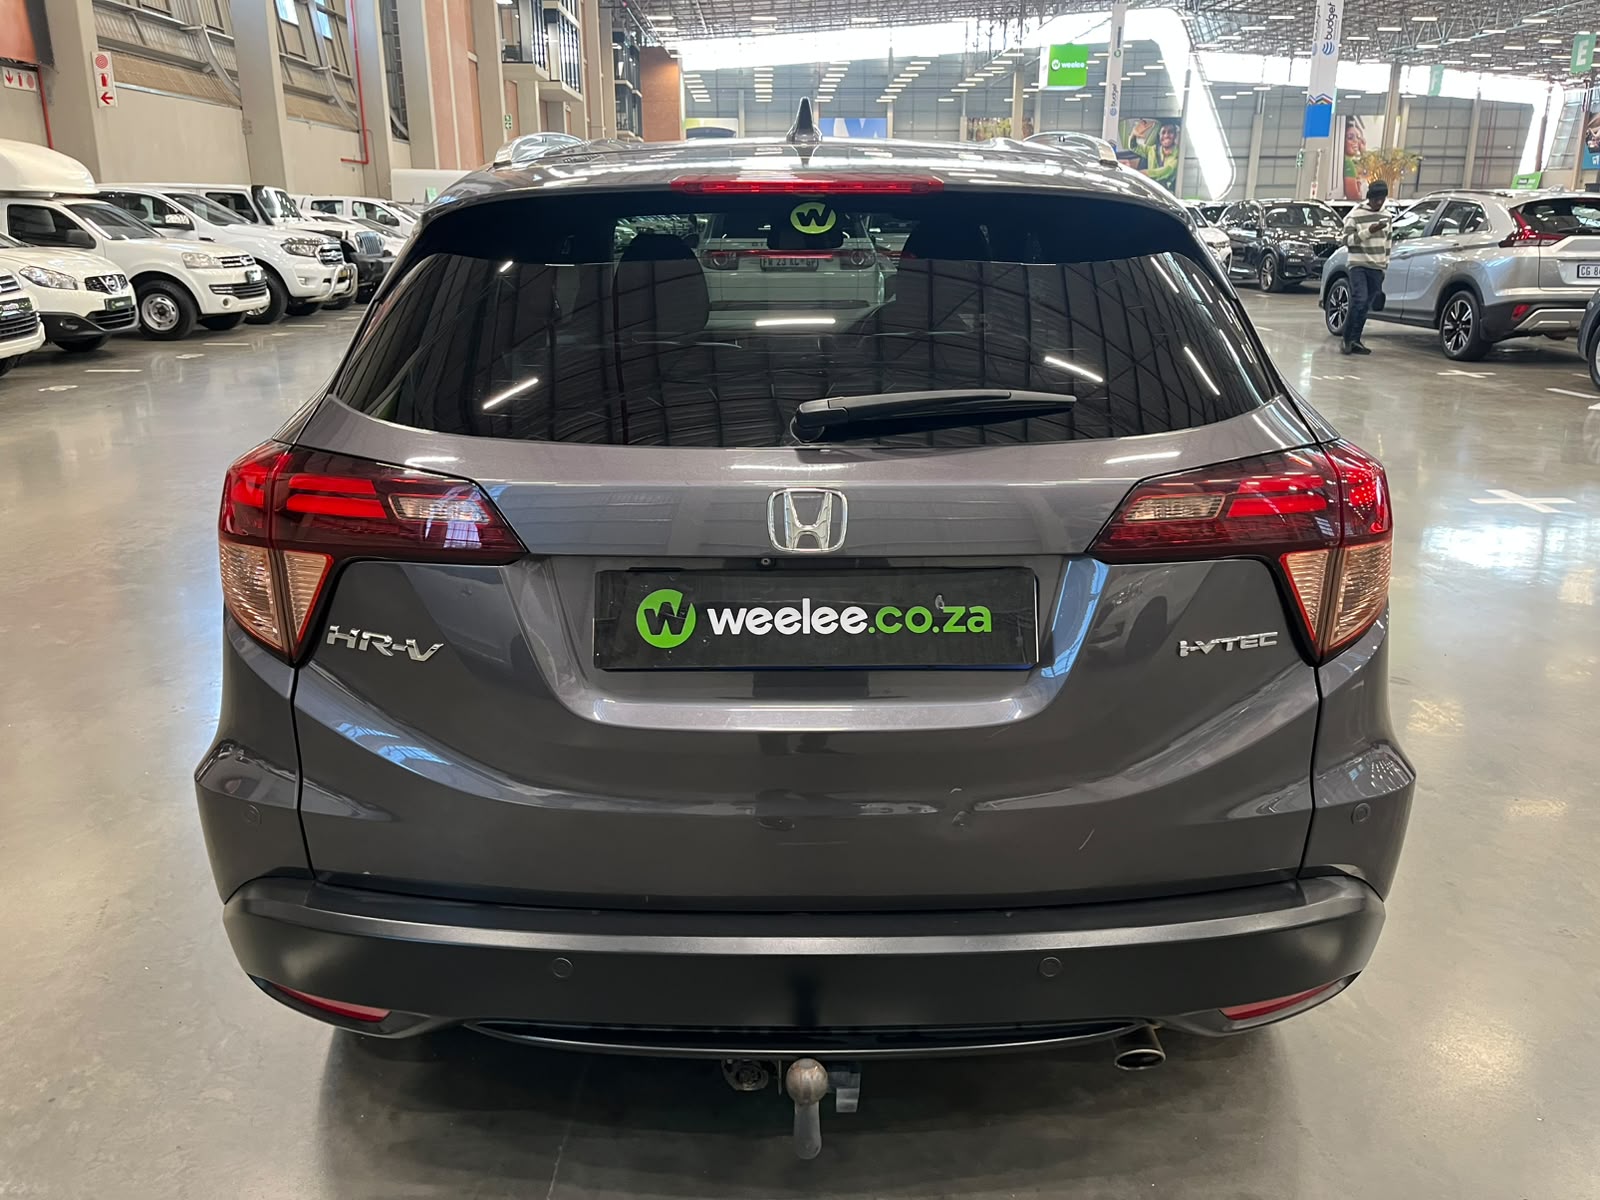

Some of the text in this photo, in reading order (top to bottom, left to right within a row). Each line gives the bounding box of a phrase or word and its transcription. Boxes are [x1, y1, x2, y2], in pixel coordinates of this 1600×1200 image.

[1324, 2, 1338, 40] budget
[1576, 40, 1589, 66] E
[1580, 266, 1600, 276] CG 8
[707, 598, 992, 635] weelee.co.za
[326, 625, 444, 662] HR-V
